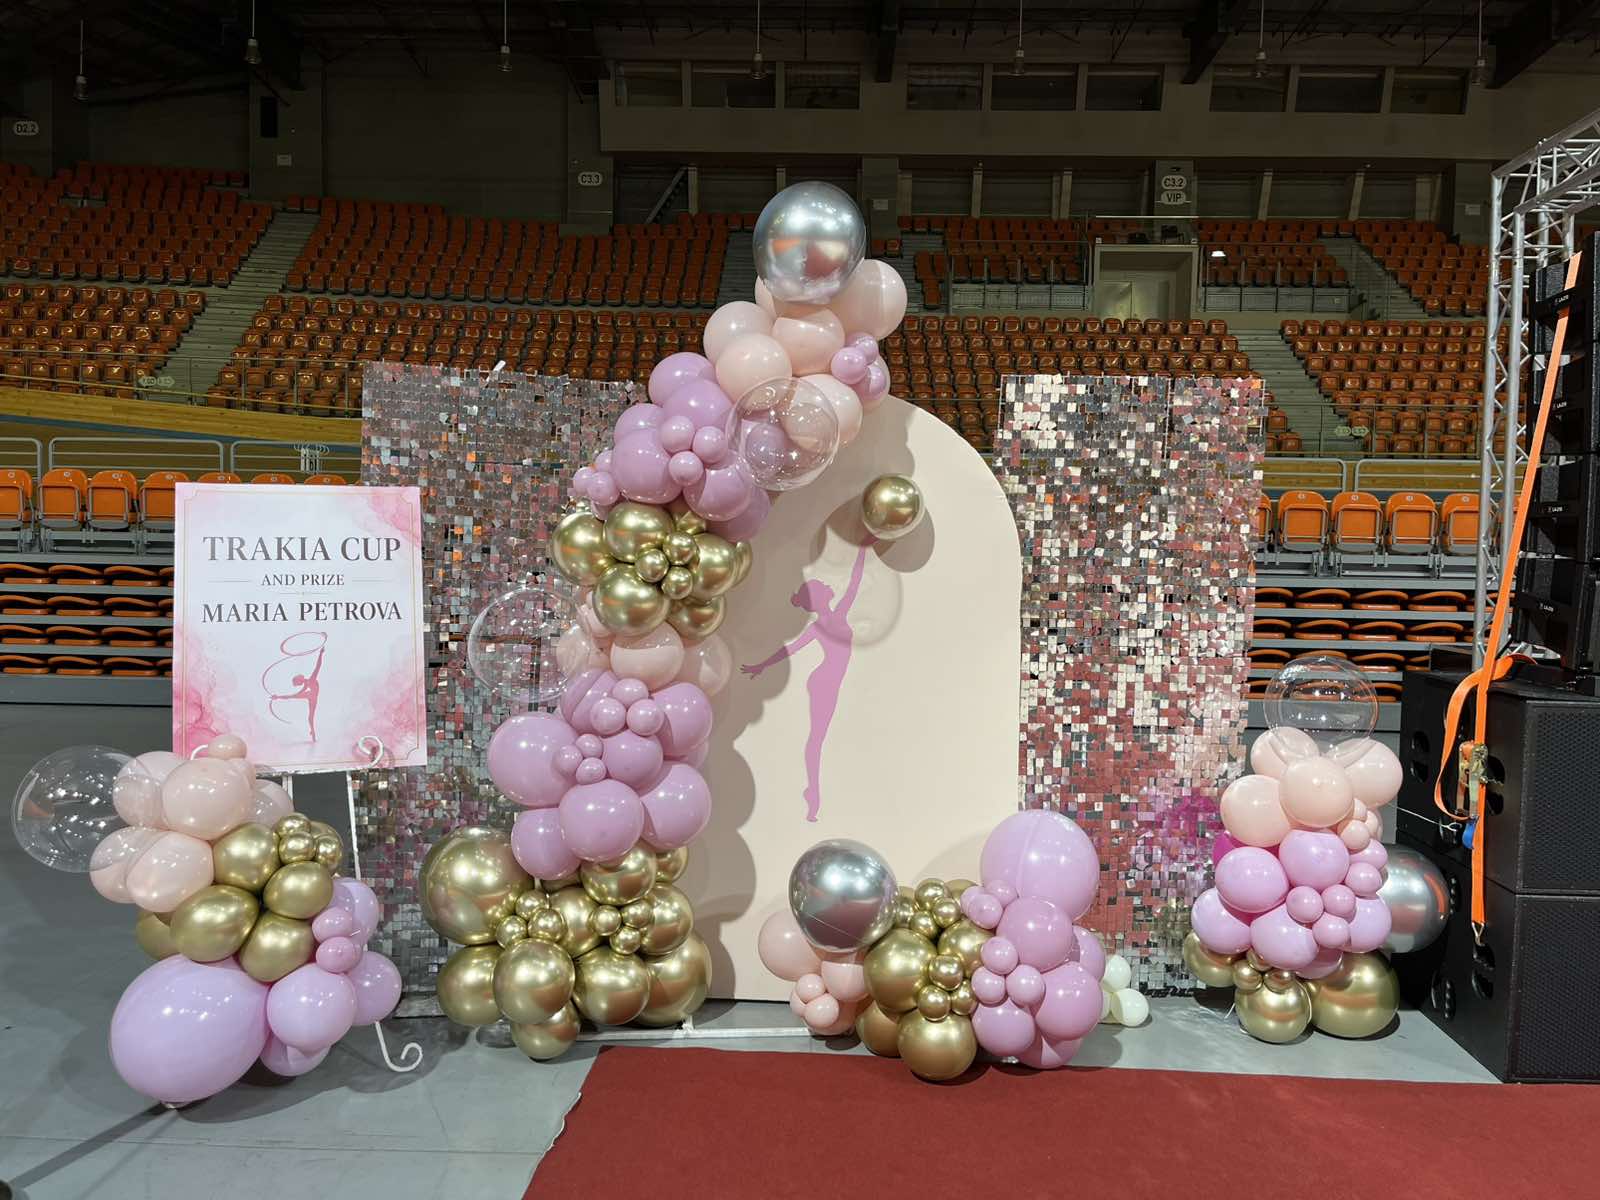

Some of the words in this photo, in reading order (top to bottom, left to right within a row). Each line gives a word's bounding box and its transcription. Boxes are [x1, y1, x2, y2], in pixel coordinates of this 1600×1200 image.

[1164, 178, 1184, 187] C3.2
[1166, 193, 1182, 203] VIP
[202, 536, 333, 562] TRAKIA
[341, 536, 401, 562] CUP
[261, 574, 295, 586] AND
[301, 574, 345, 586] PRIZE
[202, 602, 288, 623] MARIA
[299, 601, 403, 621] PETROVA
